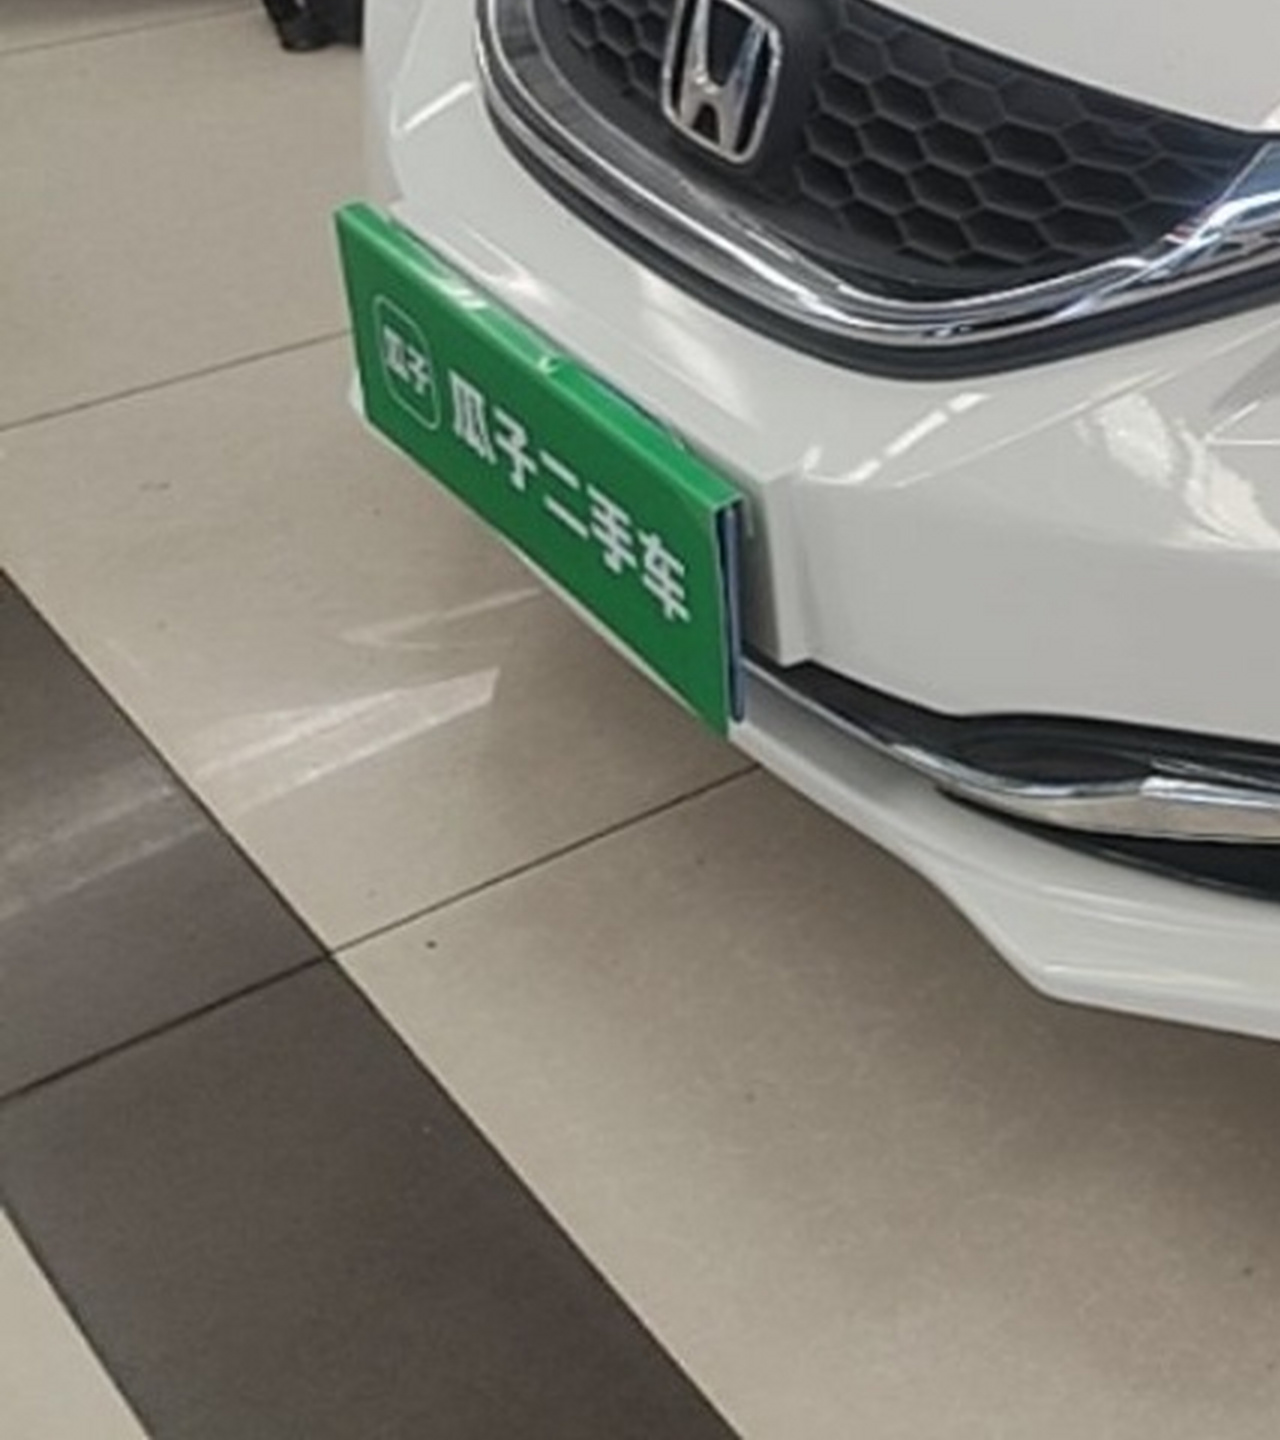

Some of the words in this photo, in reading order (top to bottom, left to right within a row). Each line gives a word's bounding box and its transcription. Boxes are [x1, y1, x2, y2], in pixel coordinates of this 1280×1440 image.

[380, 326, 432, 395] 瓜子
[448, 369, 691, 623] 瓜子二手车
